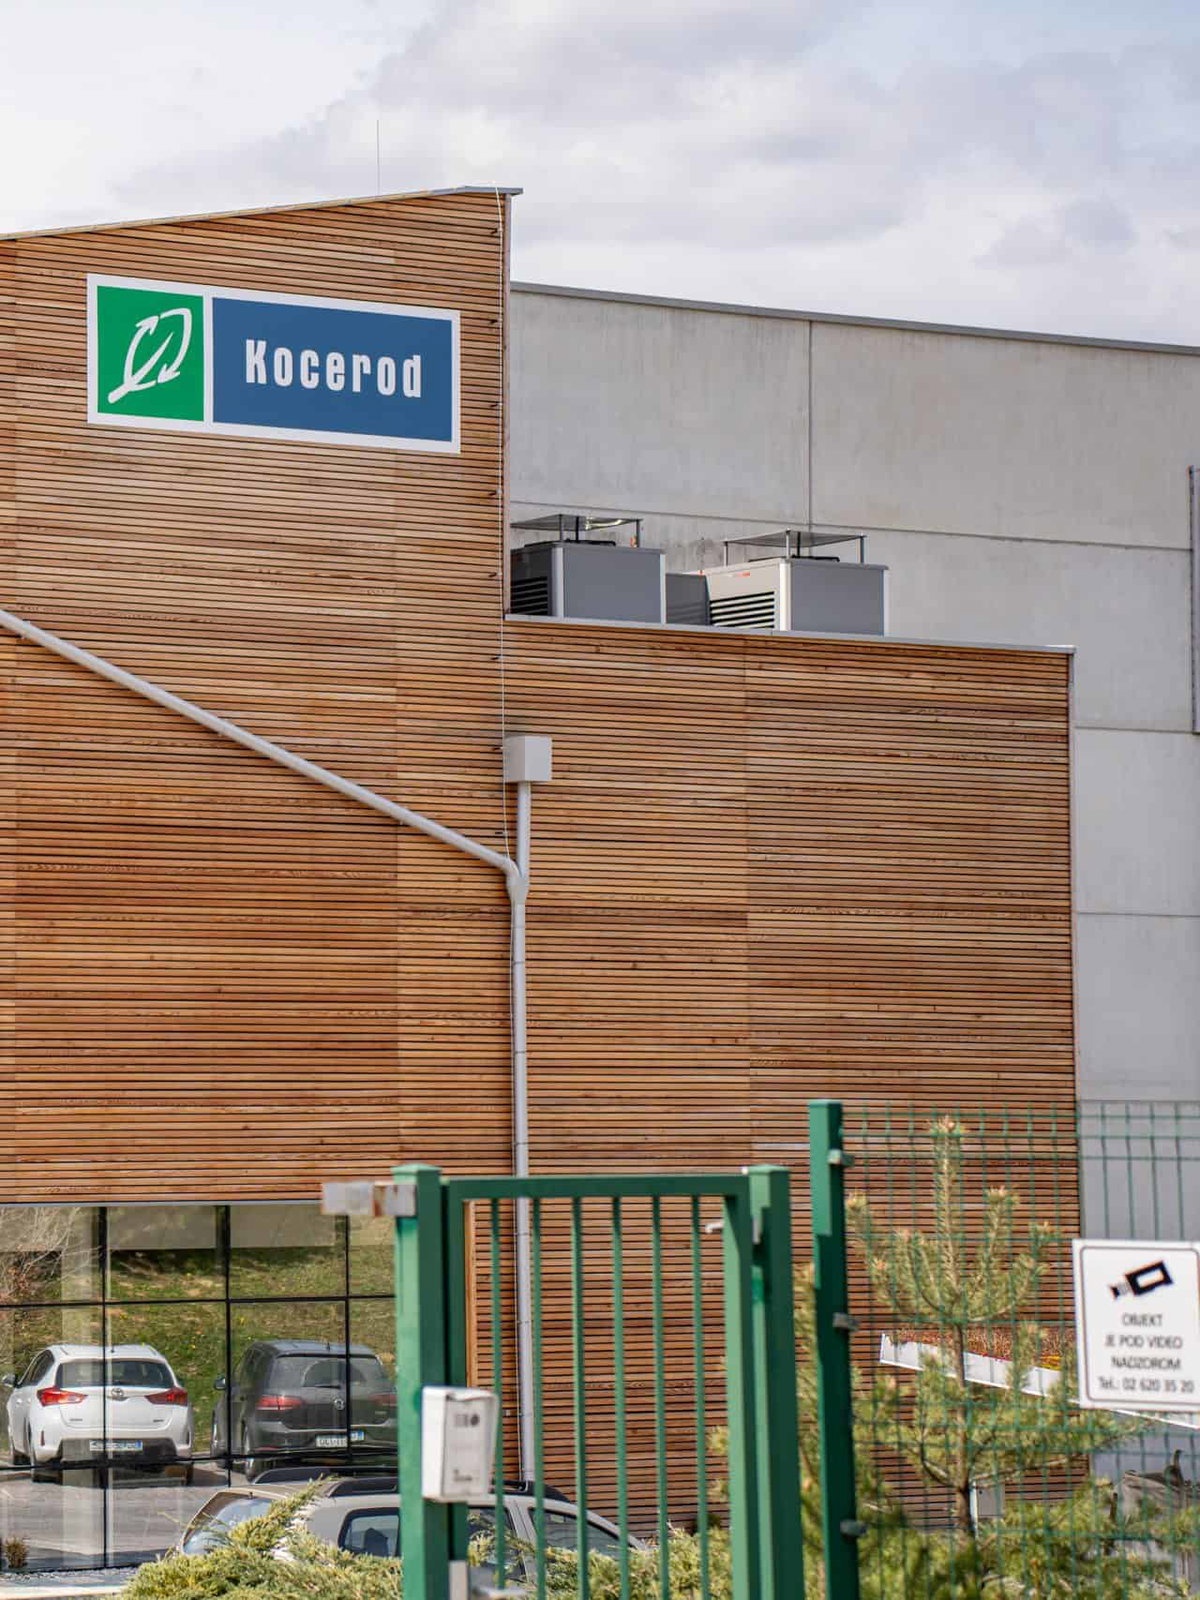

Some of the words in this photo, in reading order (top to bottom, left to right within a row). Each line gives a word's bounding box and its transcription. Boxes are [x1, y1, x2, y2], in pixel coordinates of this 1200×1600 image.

[245, 339, 421, 398] Kocerod
[1121, 1313, 1163, 1326] OBJEKT
[1104, 1334, 1115, 1347] JE
[1119, 1334, 1144, 1347] POD
[1147, 1335, 1183, 1349] VIDEO
[1111, 1355, 1182, 1370] NADZOROM
[1122, 1377, 1136, 1390] 02
[1140, 1378, 1160, 1392] 620
